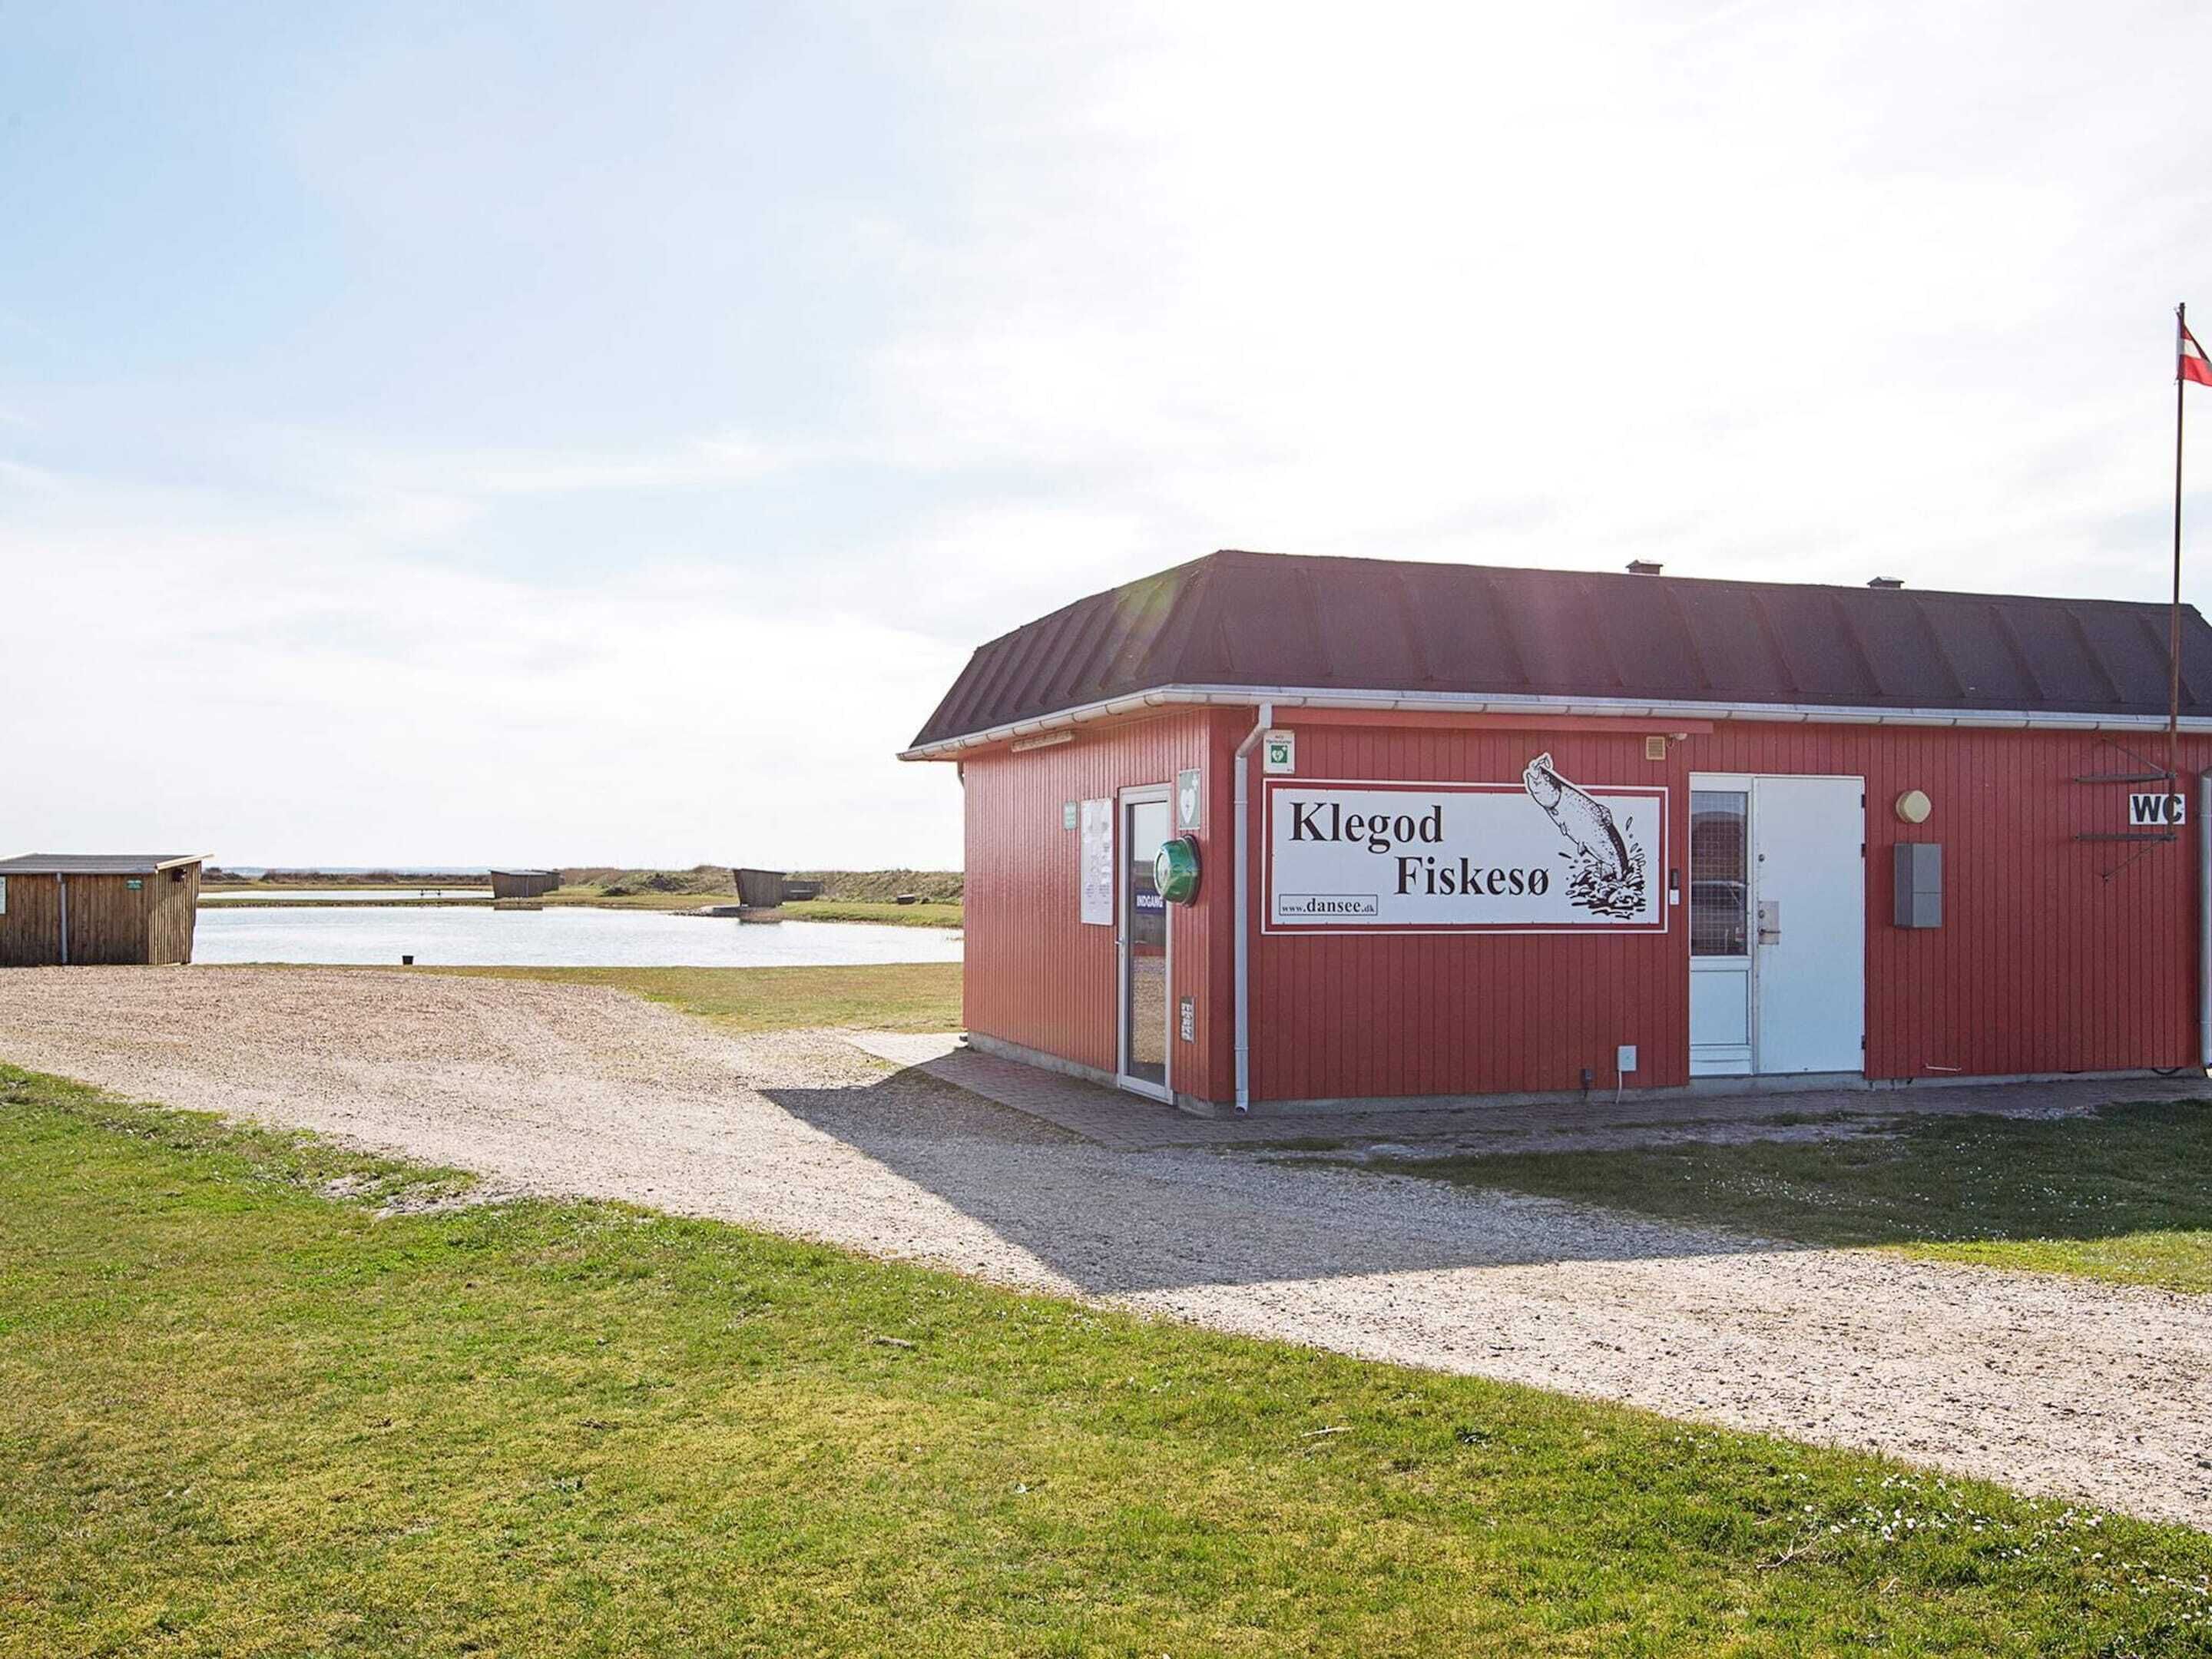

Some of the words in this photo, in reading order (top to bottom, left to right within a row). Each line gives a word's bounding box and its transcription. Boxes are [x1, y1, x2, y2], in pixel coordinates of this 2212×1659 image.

[2132, 796, 2182, 822] WC
[1289, 802, 1444, 853] Klegod
[1394, 856, 1548, 896] Fiskesø
[1282, 898, 1375, 912] www.dansee.dk
